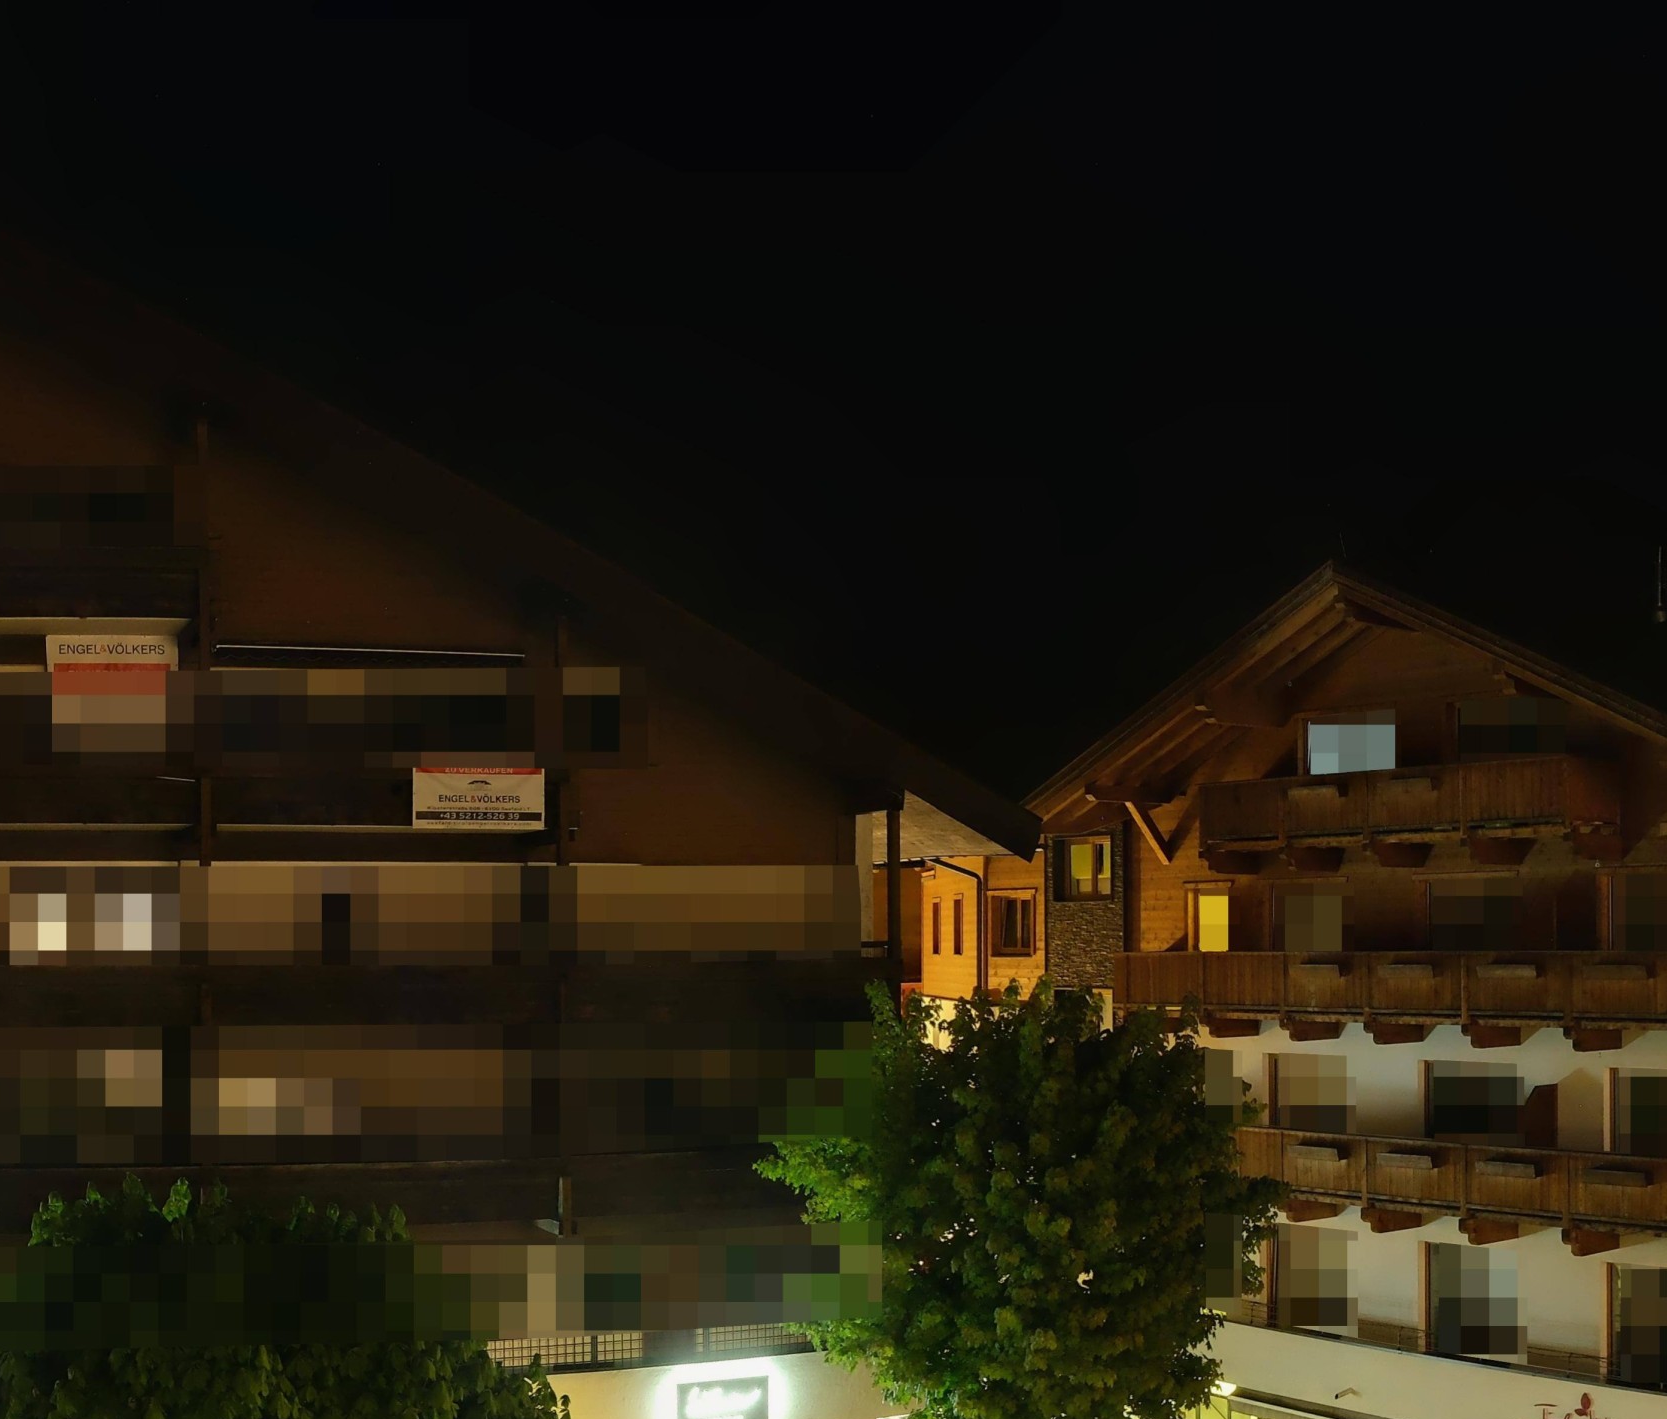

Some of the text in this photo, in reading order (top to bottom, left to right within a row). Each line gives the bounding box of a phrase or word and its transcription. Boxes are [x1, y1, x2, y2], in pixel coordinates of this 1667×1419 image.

[58, 642, 165, 655] ENGEL&VÖLKERS
[438, 794, 521, 804] ENGEL&VÖLKERS
[440, 812, 520, 820] +43 5212-526 39
